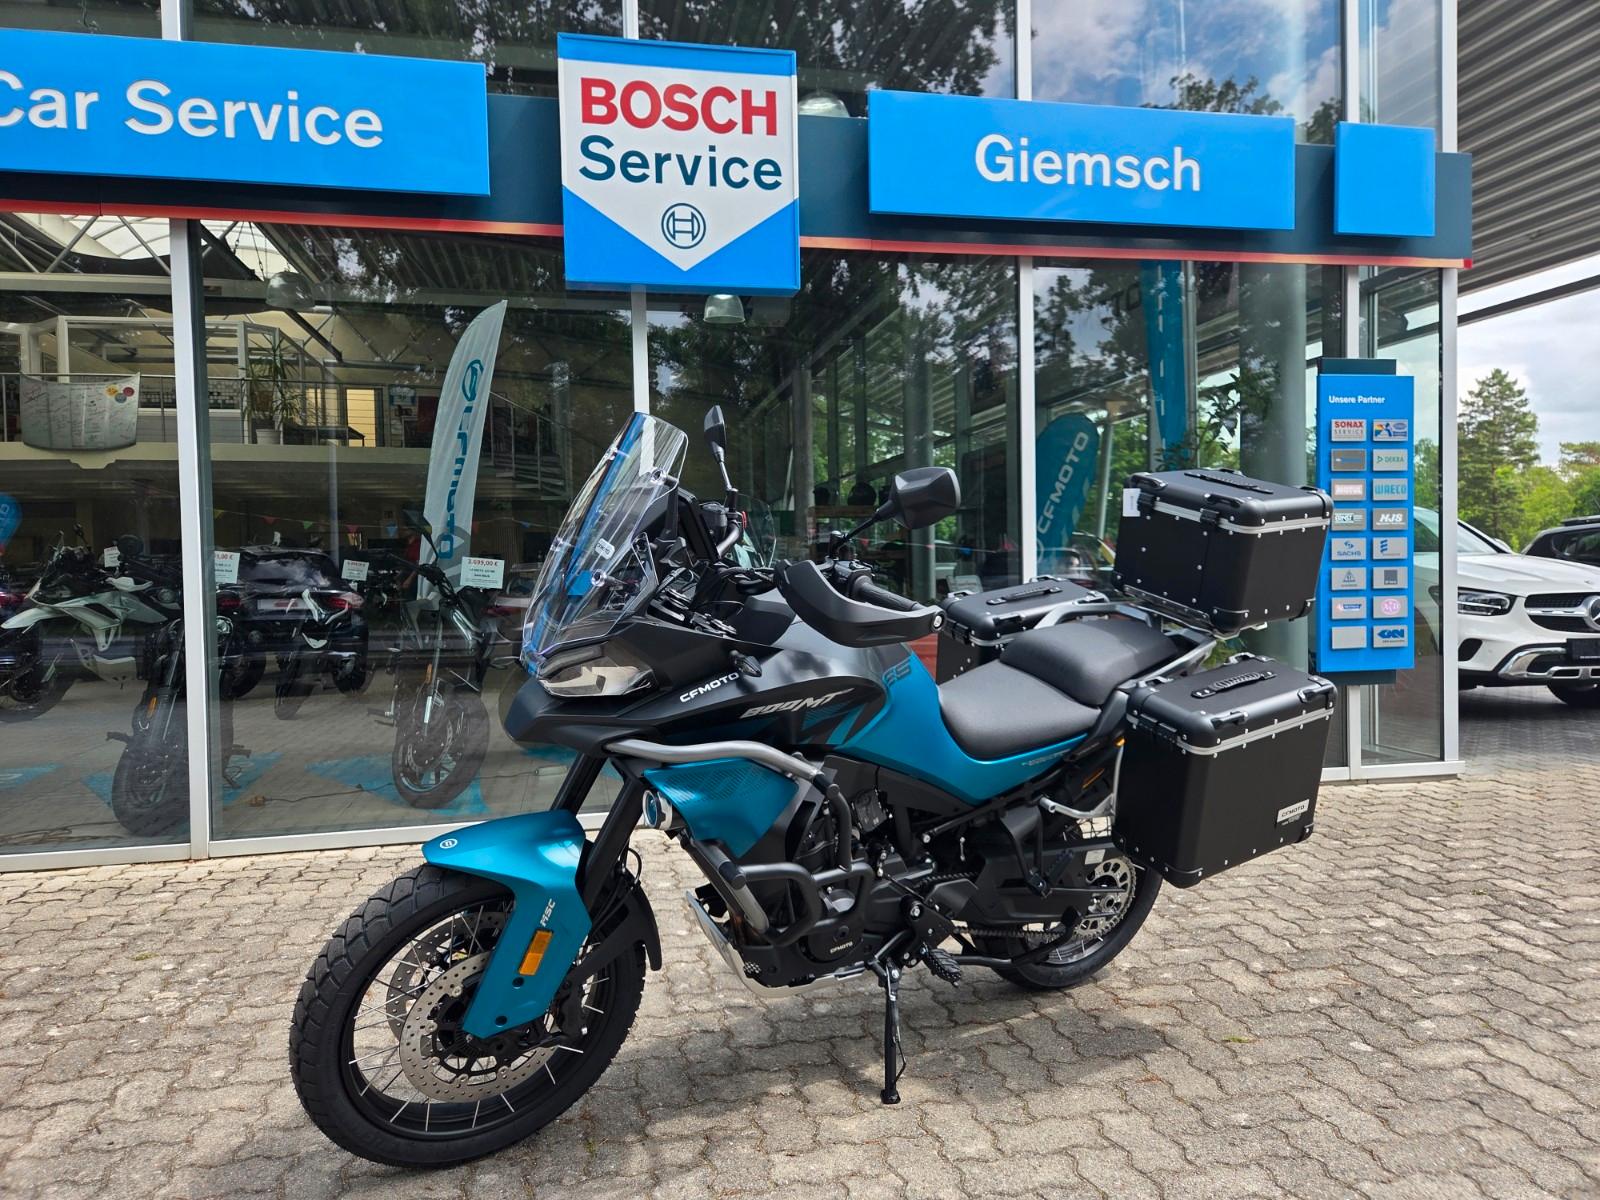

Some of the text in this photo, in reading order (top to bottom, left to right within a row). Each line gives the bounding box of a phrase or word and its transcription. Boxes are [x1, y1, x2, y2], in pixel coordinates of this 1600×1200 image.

[124, 79, 384, 148] Service
[580, 77, 777, 136] BOSCH
[578, 134, 783, 190] Service
[974, 133, 1201, 192] Giemsch
[1328, 395, 1385, 403] Unsere Partner
[1037, 431, 1089, 534] CFMOTO
[1375, 484, 1406, 494] WAECO
[1380, 513, 1403, 522] HJS
[679, 671, 740, 704] CFMOTO
[1281, 804, 1305, 818] CFMOTO
